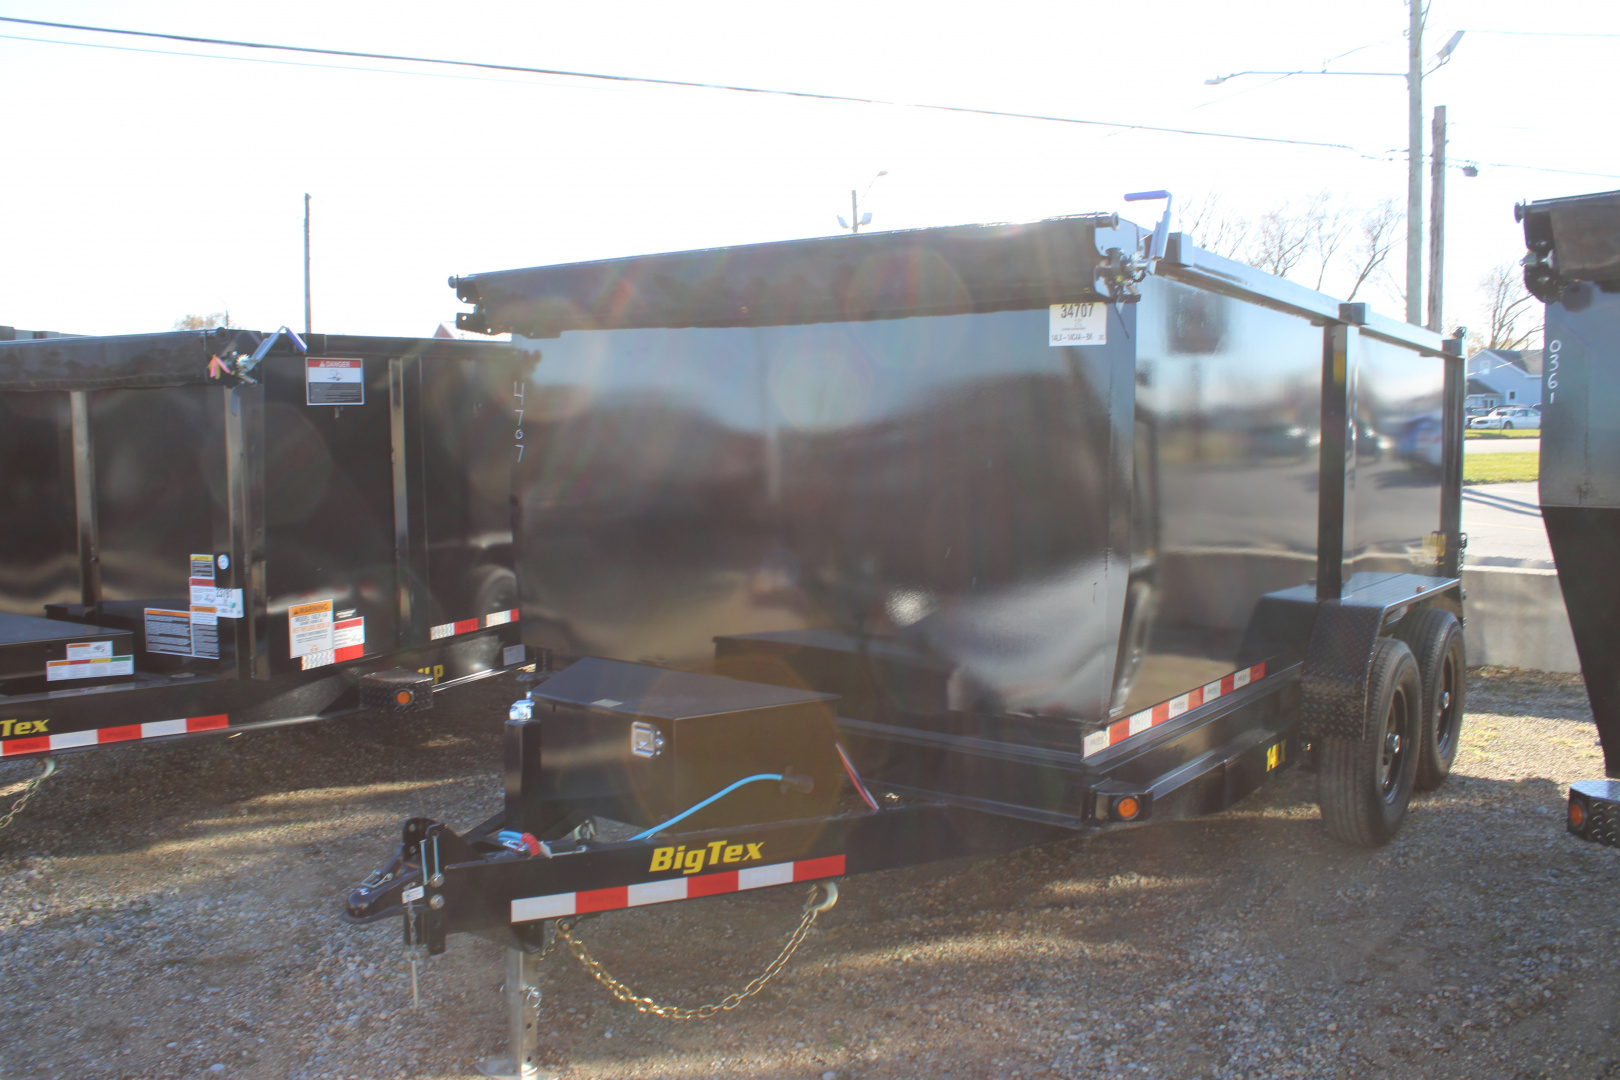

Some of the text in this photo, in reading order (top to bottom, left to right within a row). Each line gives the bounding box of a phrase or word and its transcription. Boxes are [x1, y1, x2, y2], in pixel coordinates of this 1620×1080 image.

[1061, 303, 1094, 318] 34707
[1548, 339, 1562, 404] 0361
[299, 603, 329, 613] WARNING
[648, 840, 765, 874] BigTex
